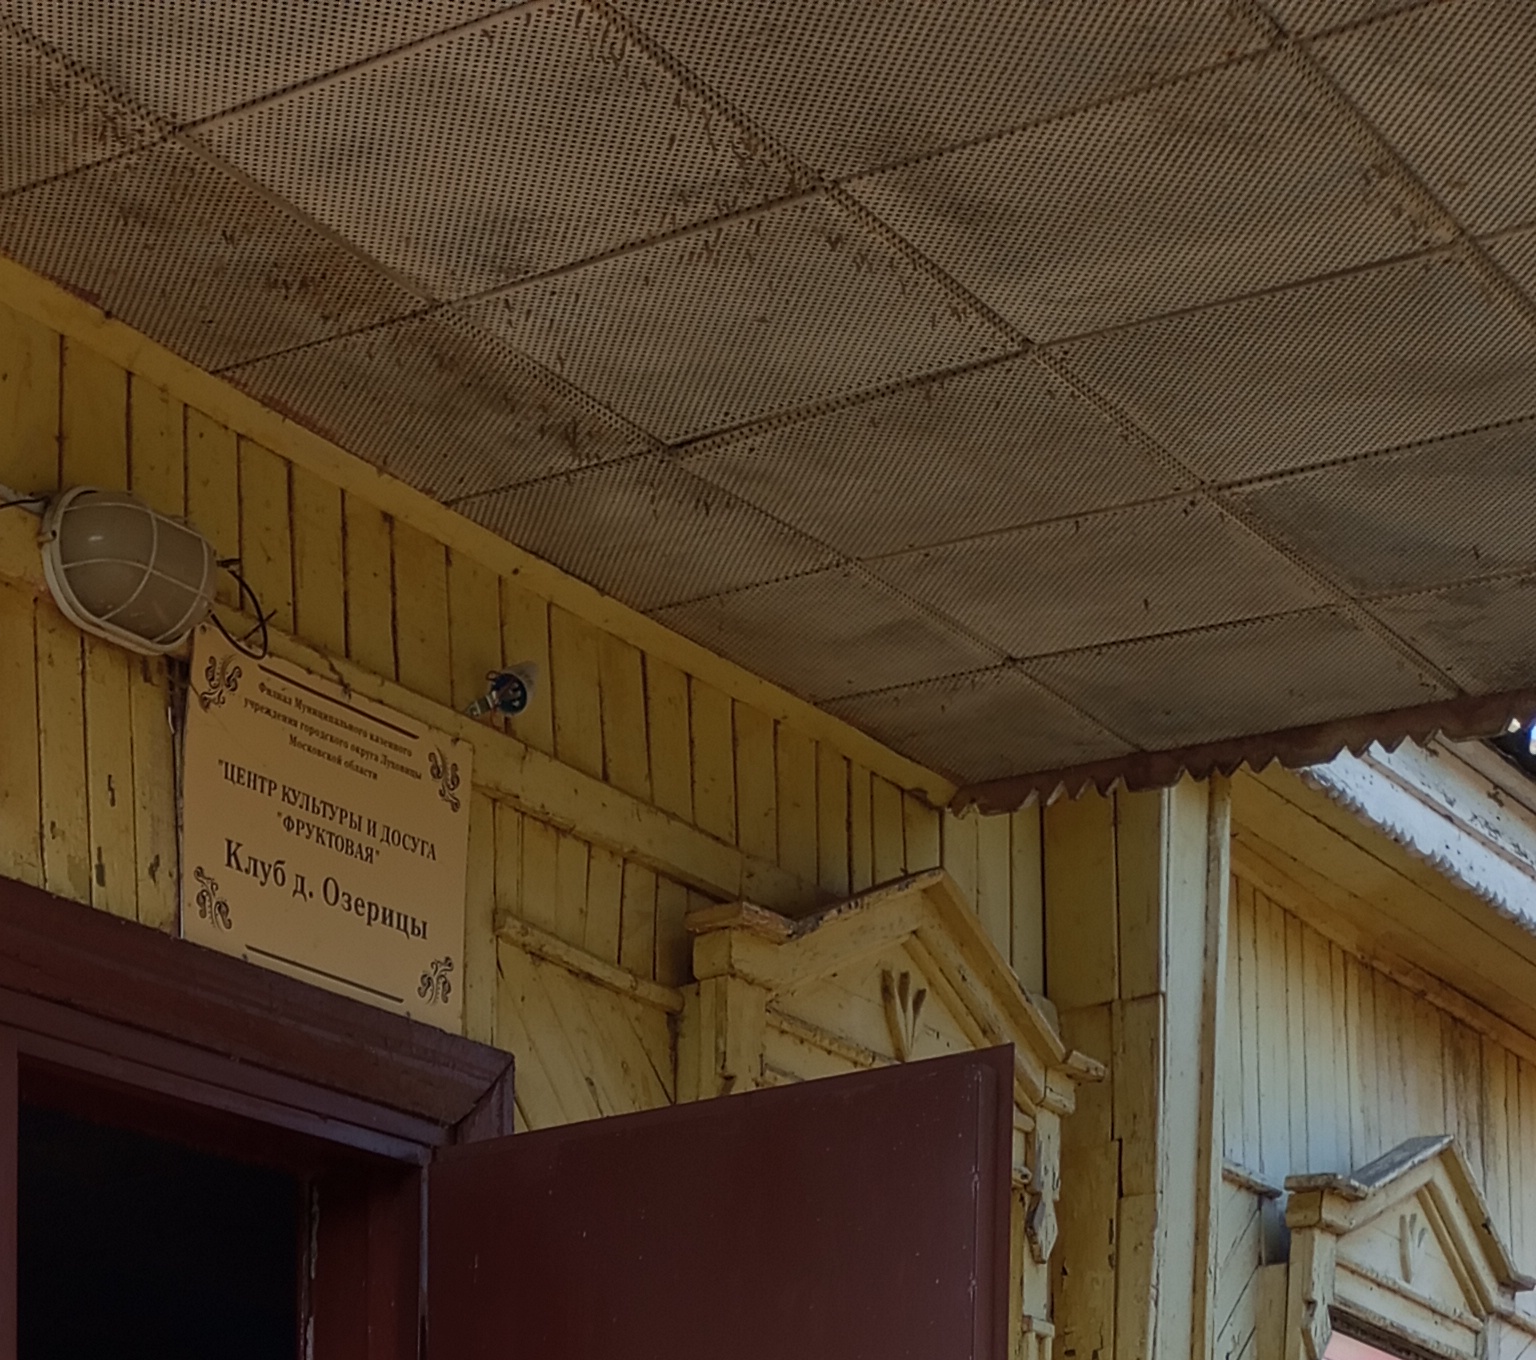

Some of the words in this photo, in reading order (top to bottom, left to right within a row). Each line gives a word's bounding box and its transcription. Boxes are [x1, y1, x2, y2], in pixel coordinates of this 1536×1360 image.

[289, 733, 342, 766] Московской
[218, 759, 277, 797] "ЦЕНТР
[281, 784, 362, 832] КУЛЬТУРЫ
[366, 818, 377, 838] И
[380, 824, 437, 861] ДОСУГА
[277, 812, 380, 864] "ФРУКТОВАЯ"
[225, 838, 286, 887] Клуб
[292, 873, 314, 903] д.
[323, 876, 428, 940] Озерицы
